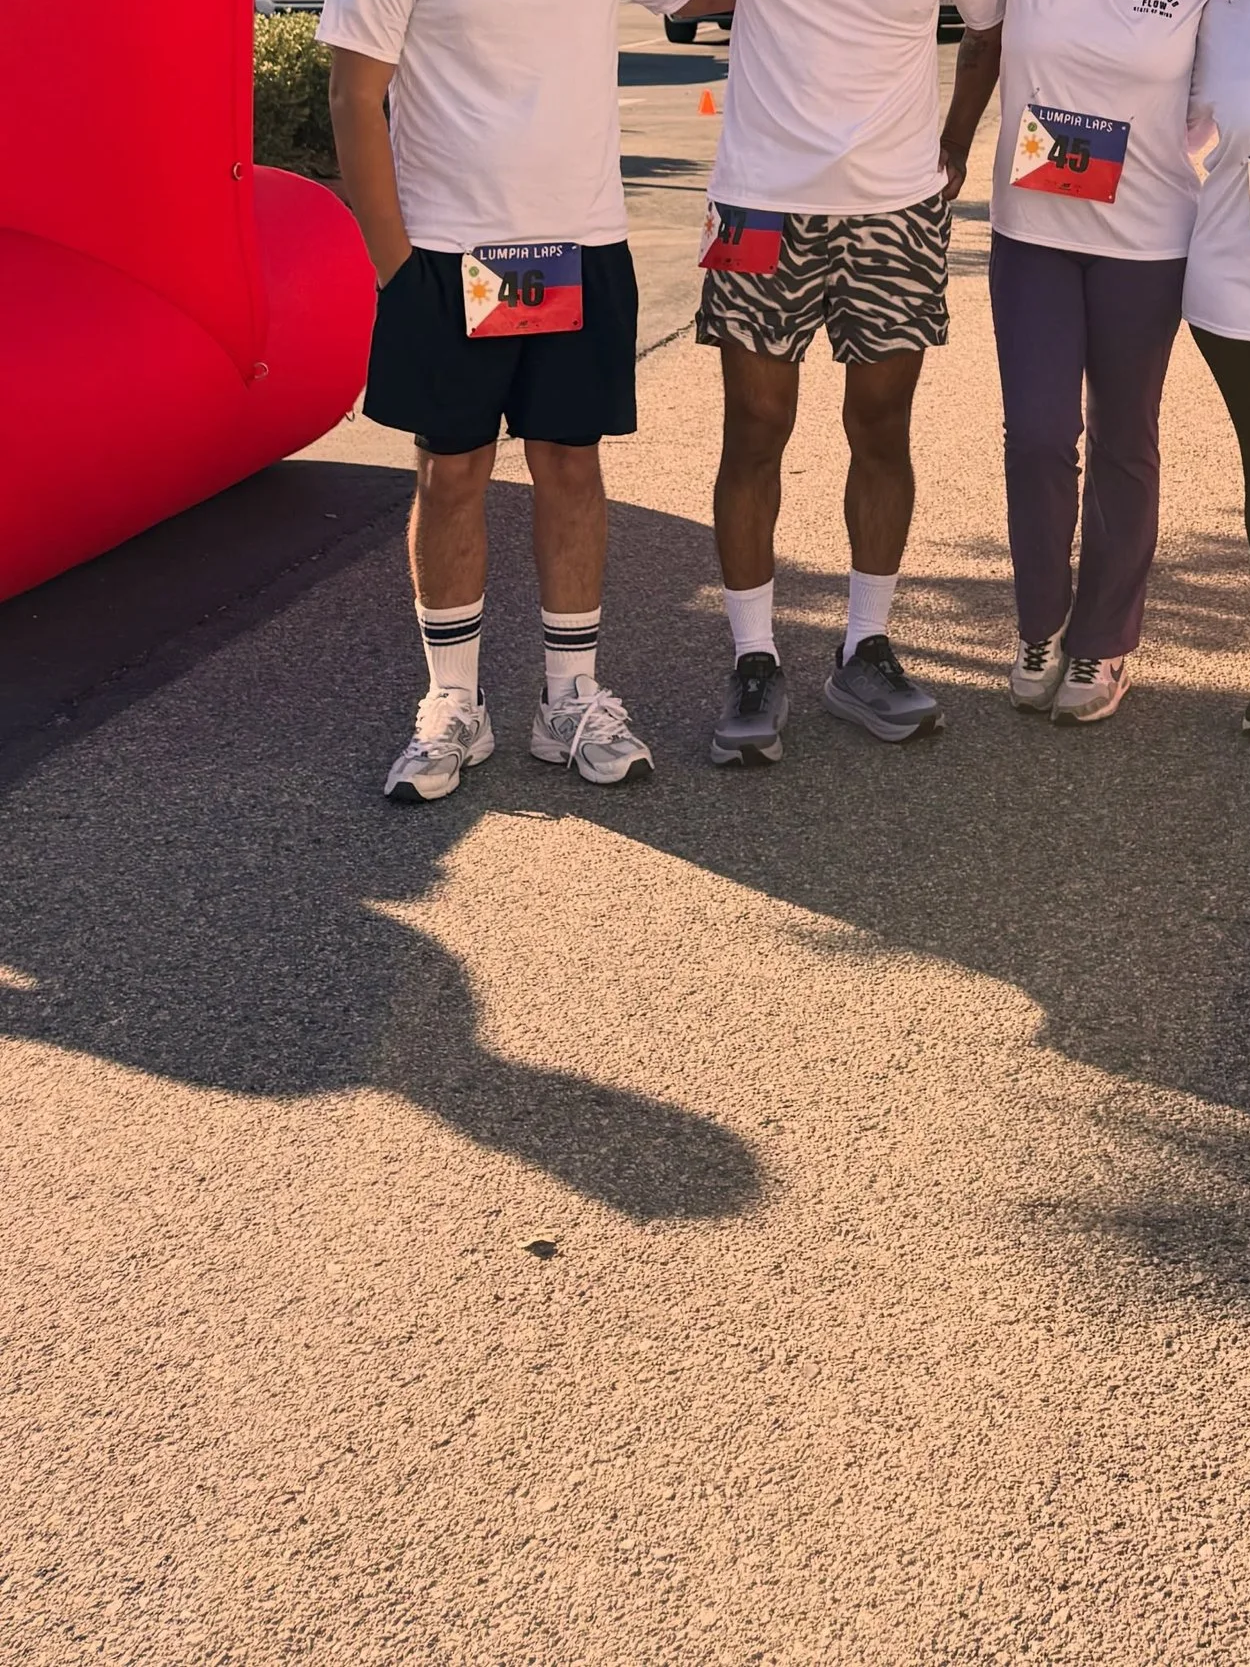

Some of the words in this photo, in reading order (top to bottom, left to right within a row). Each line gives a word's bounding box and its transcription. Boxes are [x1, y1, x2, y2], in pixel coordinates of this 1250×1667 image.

[1142, 0, 1167, 10] FLOW
[1039, 110, 1082, 126] LUMPIA
[1086, 119, 1113, 132] LAPS
[1048, 134, 1091, 173] 45
[718, 210, 746, 245] 47
[480, 248, 529, 260] LUMPIA
[534, 245, 563, 258] LAPS
[498, 270, 545, 308] 46
